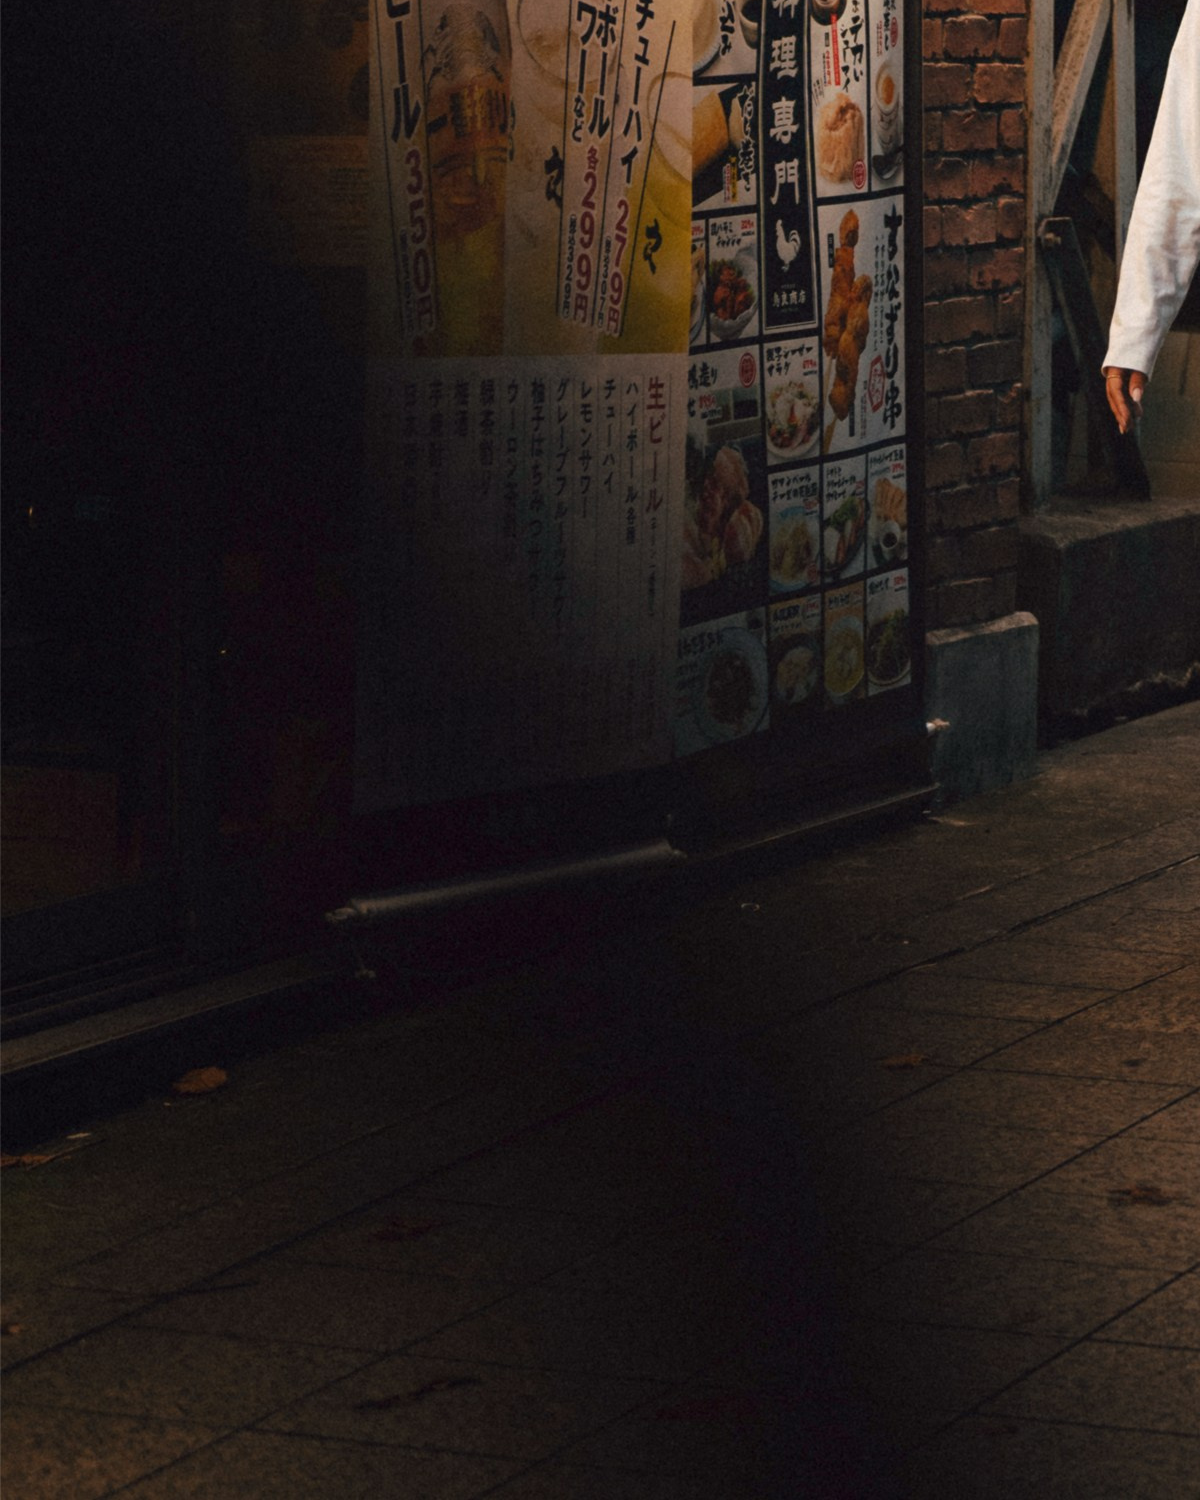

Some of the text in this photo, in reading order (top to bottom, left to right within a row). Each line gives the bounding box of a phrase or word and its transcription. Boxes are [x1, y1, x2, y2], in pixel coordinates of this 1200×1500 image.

[579, 382, 593, 519] レモンサワー
[603, 380, 616, 494] チューハイ
[646, 377, 666, 514] 生ビール
